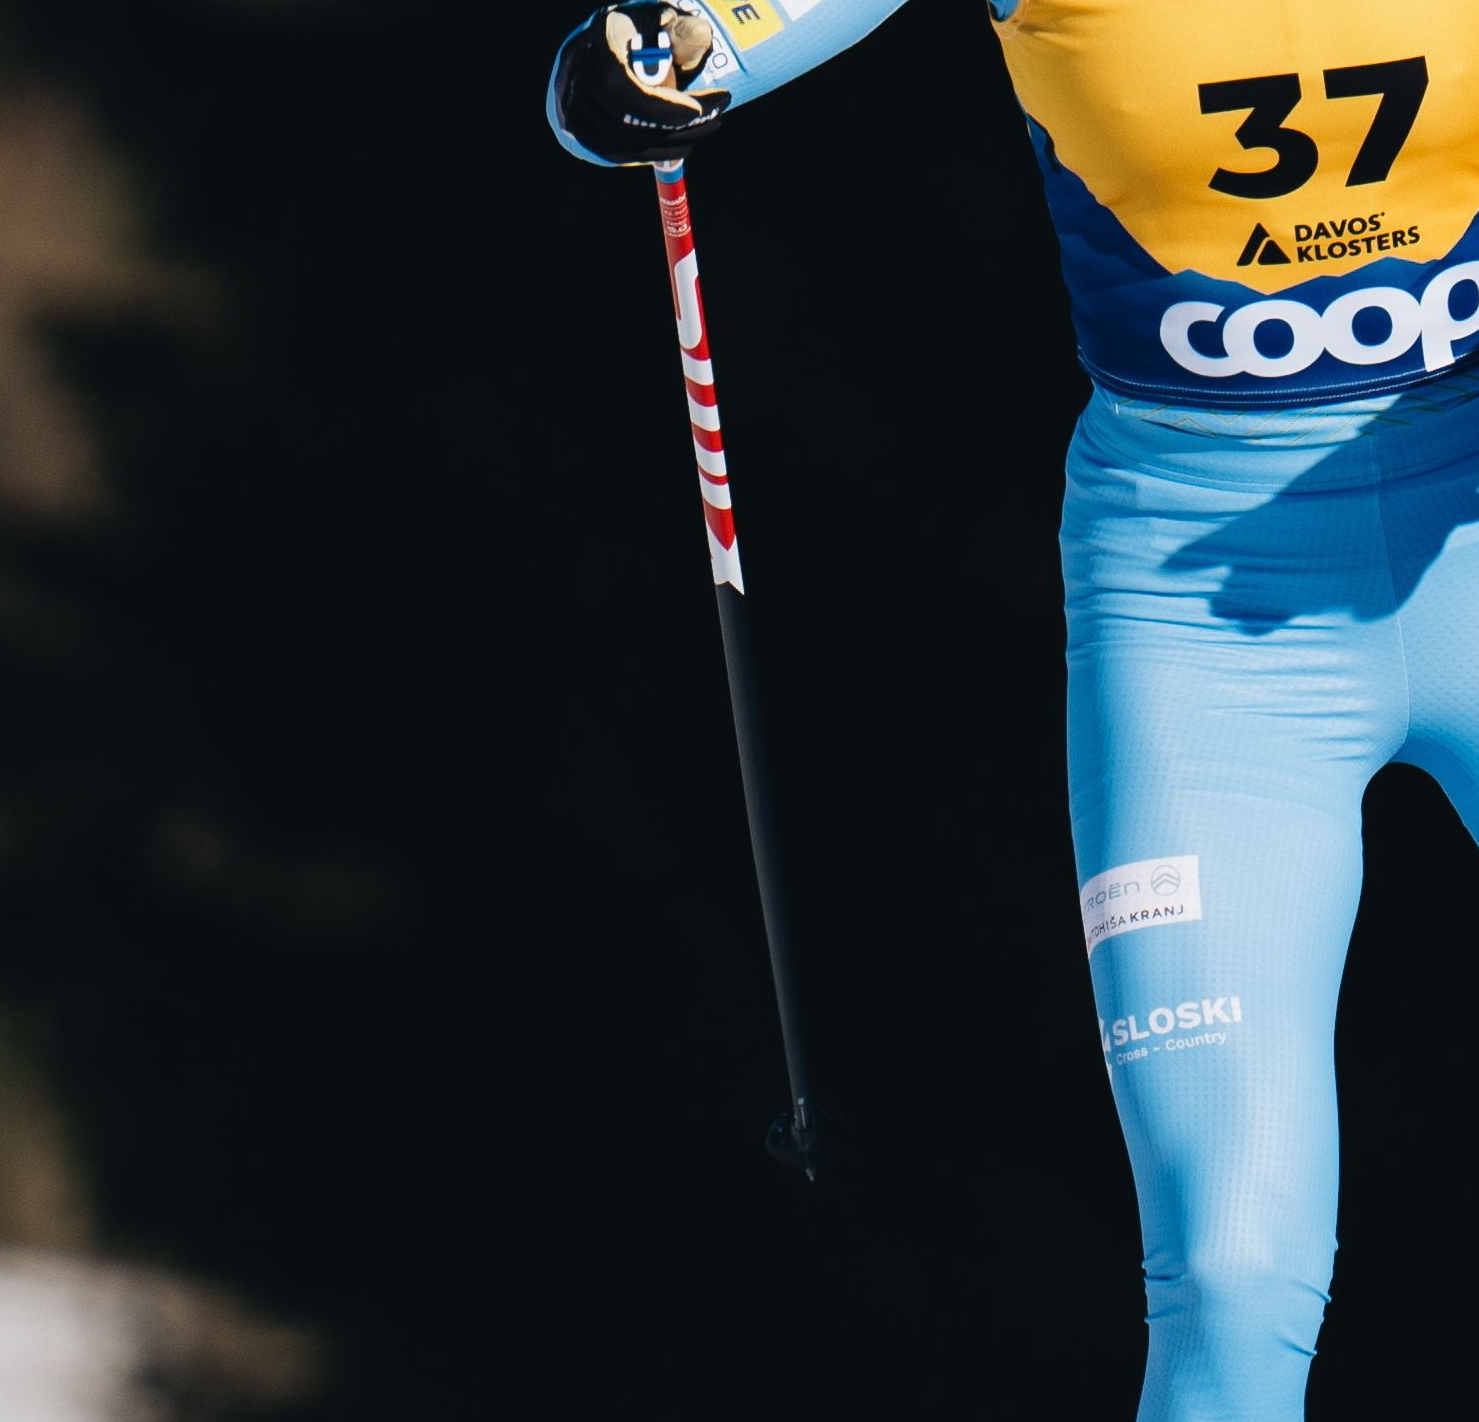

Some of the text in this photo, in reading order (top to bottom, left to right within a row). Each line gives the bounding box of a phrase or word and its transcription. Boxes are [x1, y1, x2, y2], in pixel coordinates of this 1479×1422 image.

[1197, 55, 1430, 200] 37
[1294, 212, 1384, 243] DAVOS
[1297, 225, 1421, 263] KLOSTERS
[1130, 904, 1185, 924] KRANJ
[1112, 996, 1243, 1047] SLOSKI
[1116, 1045, 1149, 1066] Cross
[1165, 1031, 1227, 1052] Country
